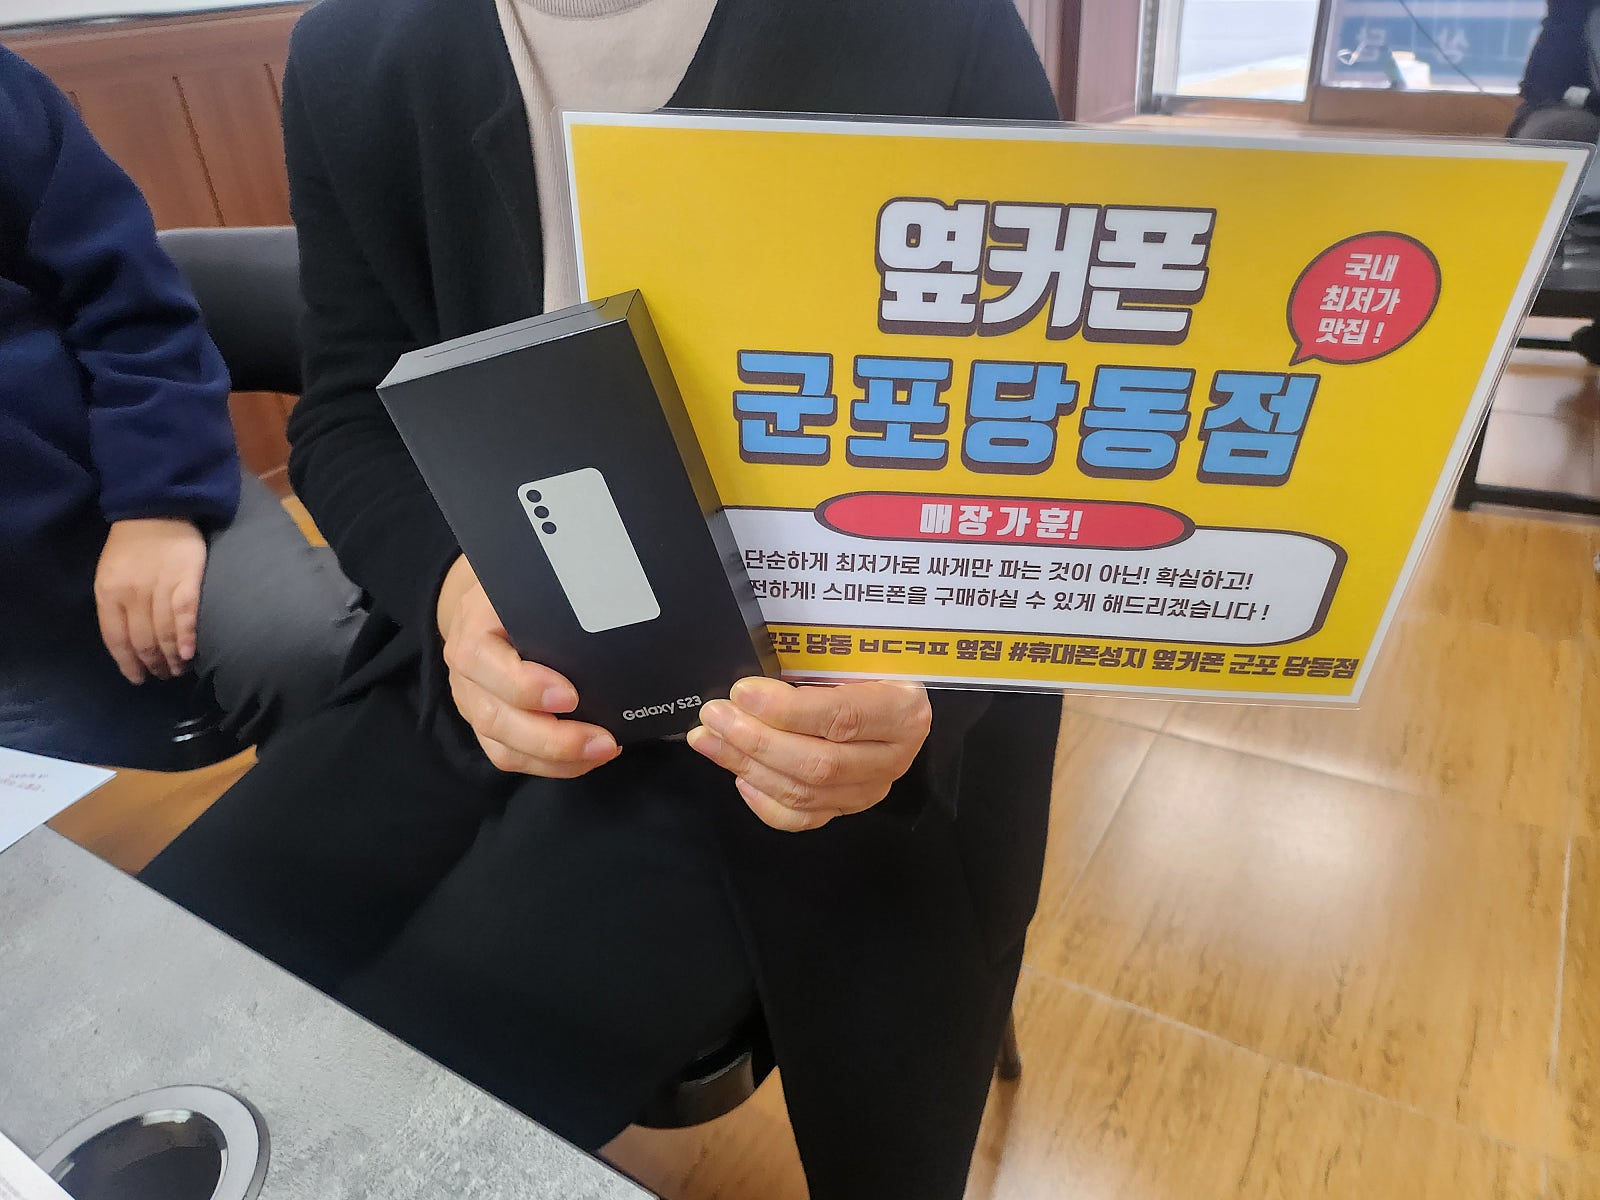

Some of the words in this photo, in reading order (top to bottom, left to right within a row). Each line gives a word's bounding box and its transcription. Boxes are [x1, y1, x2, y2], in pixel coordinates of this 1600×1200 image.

[876, 197, 1217, 343] 옆커폰
[1344, 253, 1400, 282] 국내
[1319, 284, 1401, 315] 최저가
[744, 549, 829, 571] 단순하게
[835, 552, 921, 575] 최저가로
[927, 556, 993, 578] 싸게만
[999, 559, 1042, 581] 파는
[1048, 562, 1092, 583] 것이
[1099, 565, 1150, 586] 아닌!
[1156, 566, 1254, 591] 확실하고!
[822, 582, 928, 606] 스마트폰을
[934, 587, 1018, 609] 구매하실
[1025, 590, 1046, 611] 수
[1053, 591, 1095, 613] 있게
[1102, 594, 1257, 621] 해드리겠습니다
[806, 633, 853, 656] 당동
[956, 639, 1002, 662] 옆집
[1008, 641, 1147, 669] #휴대폰성지
[1152, 649, 1225, 674] 옆커폰
[1228, 653, 1281, 677] 군포
[1282, 656, 1360, 680] 당동점
[622, 702, 675, 721] Galaxy
[676, 695, 702, 710] S23
